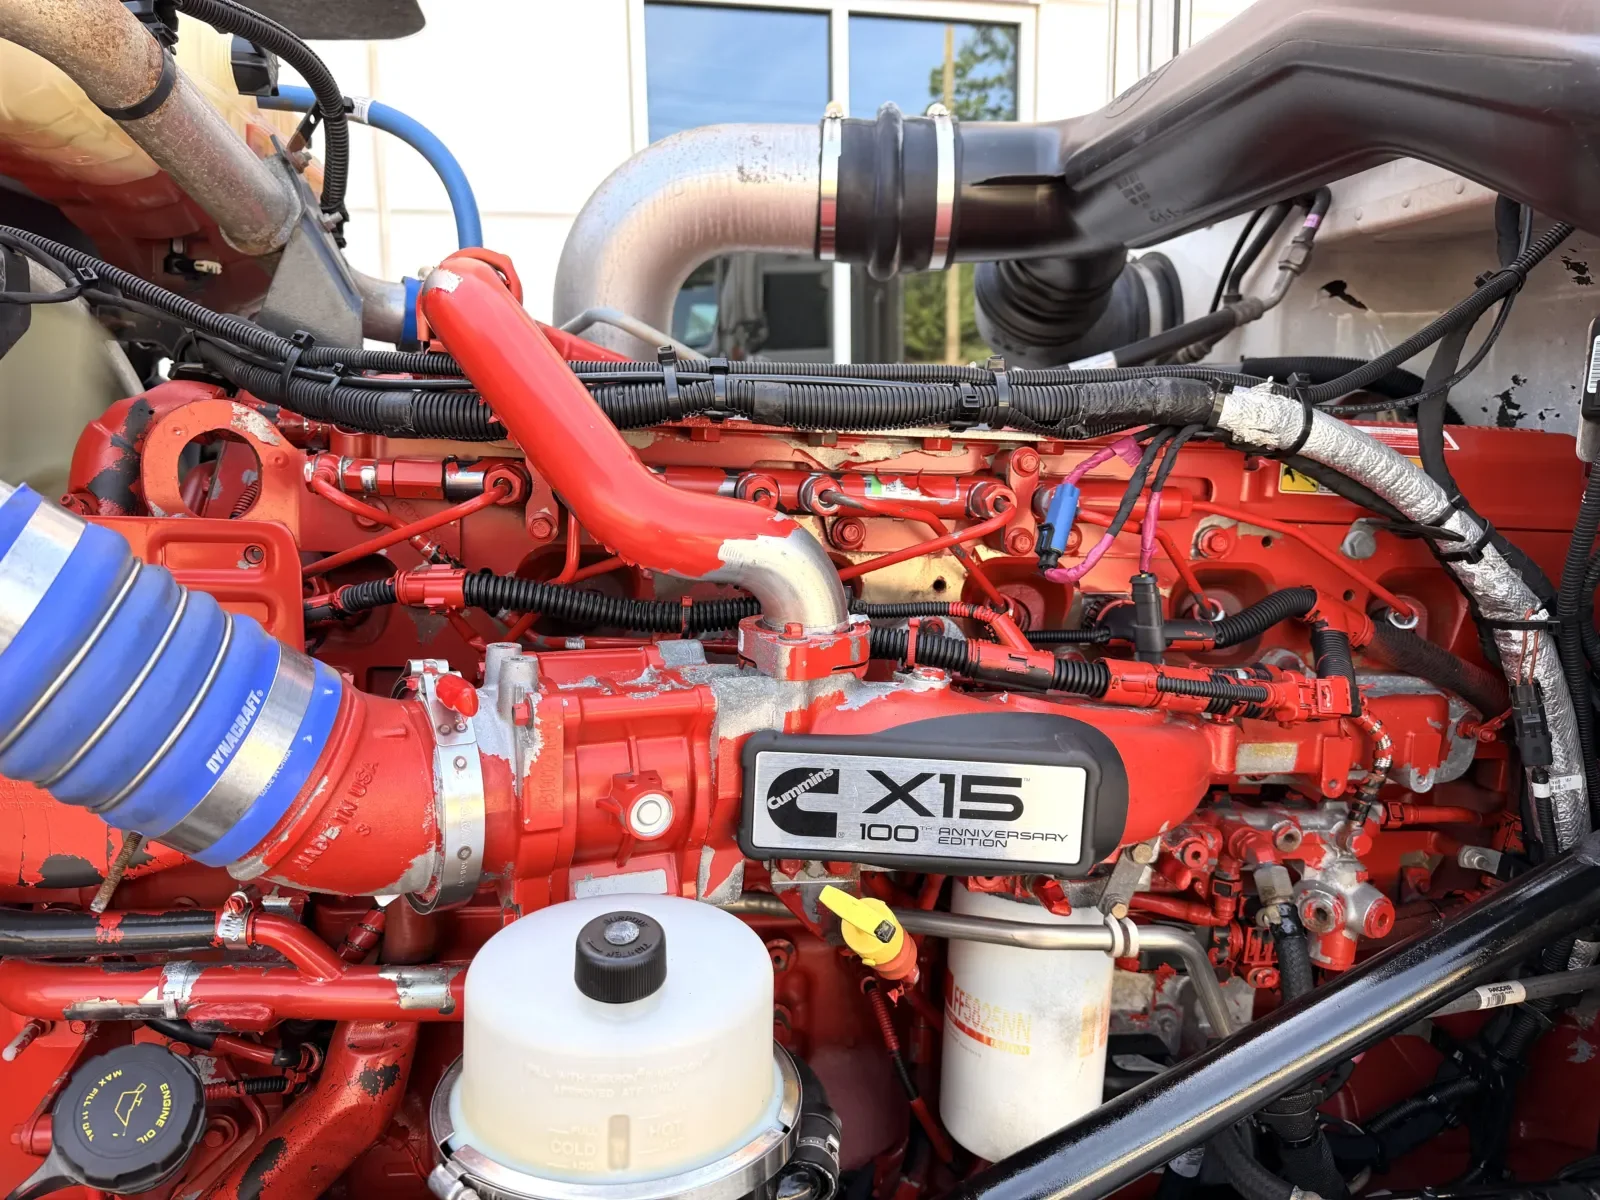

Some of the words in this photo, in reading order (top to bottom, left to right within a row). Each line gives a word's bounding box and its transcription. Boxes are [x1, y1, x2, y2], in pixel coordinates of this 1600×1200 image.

[205, 689, 261, 775] DYNACRAFT
[766, 768, 835, 811] Cummins
[862, 769, 1025, 822] X15
[292, 824, 343, 871] MADE
[333, 799, 359, 826] IN
[348, 761, 380, 799] USA
[938, 826, 1069, 843] ANNIVERSARY
[938, 836, 1008, 848] EDITION
[98, 1069, 123, 1087] MAX
[83, 1087, 99, 1108] FILL
[155, 1083, 172, 1127] ENGINE
[82, 1122, 95, 1142] GAL
[136, 1129, 157, 1144] OIL
[649, 1117, 684, 1138] HOT
[550, 1138, 597, 1156] COLD
